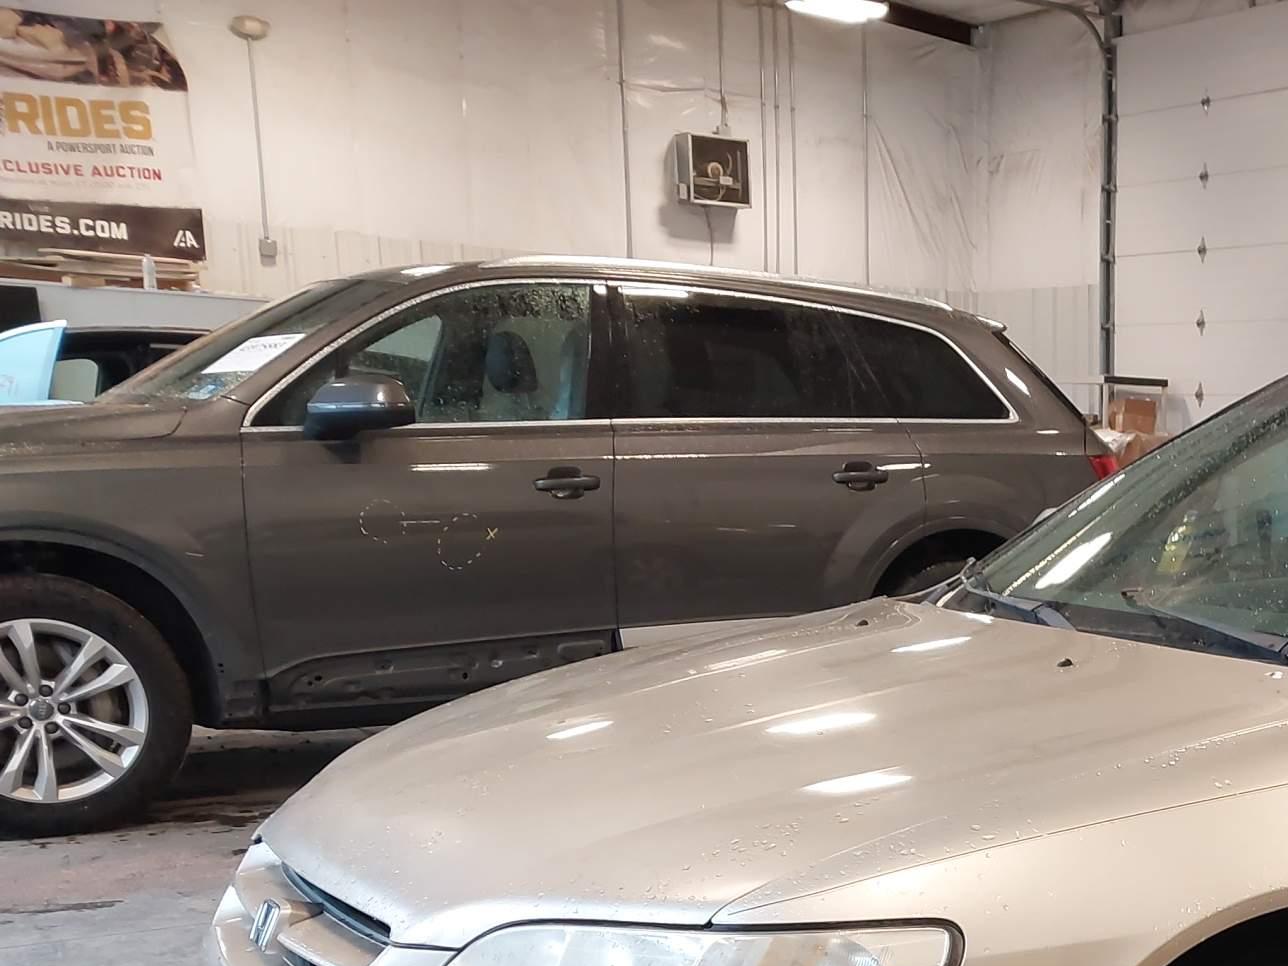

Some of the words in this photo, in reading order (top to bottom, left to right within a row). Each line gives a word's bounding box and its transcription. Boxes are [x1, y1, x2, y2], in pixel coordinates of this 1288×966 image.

[2, 92, 153, 140] RIDES
[56, 141, 118, 155] POWERSPORT
[119, 143, 155, 157] AUCTION
[0, 159, 84, 177] CLUSIVE
[91, 164, 163, 181] AUCTION
[0, 211, 129, 241] RIDES.COM
